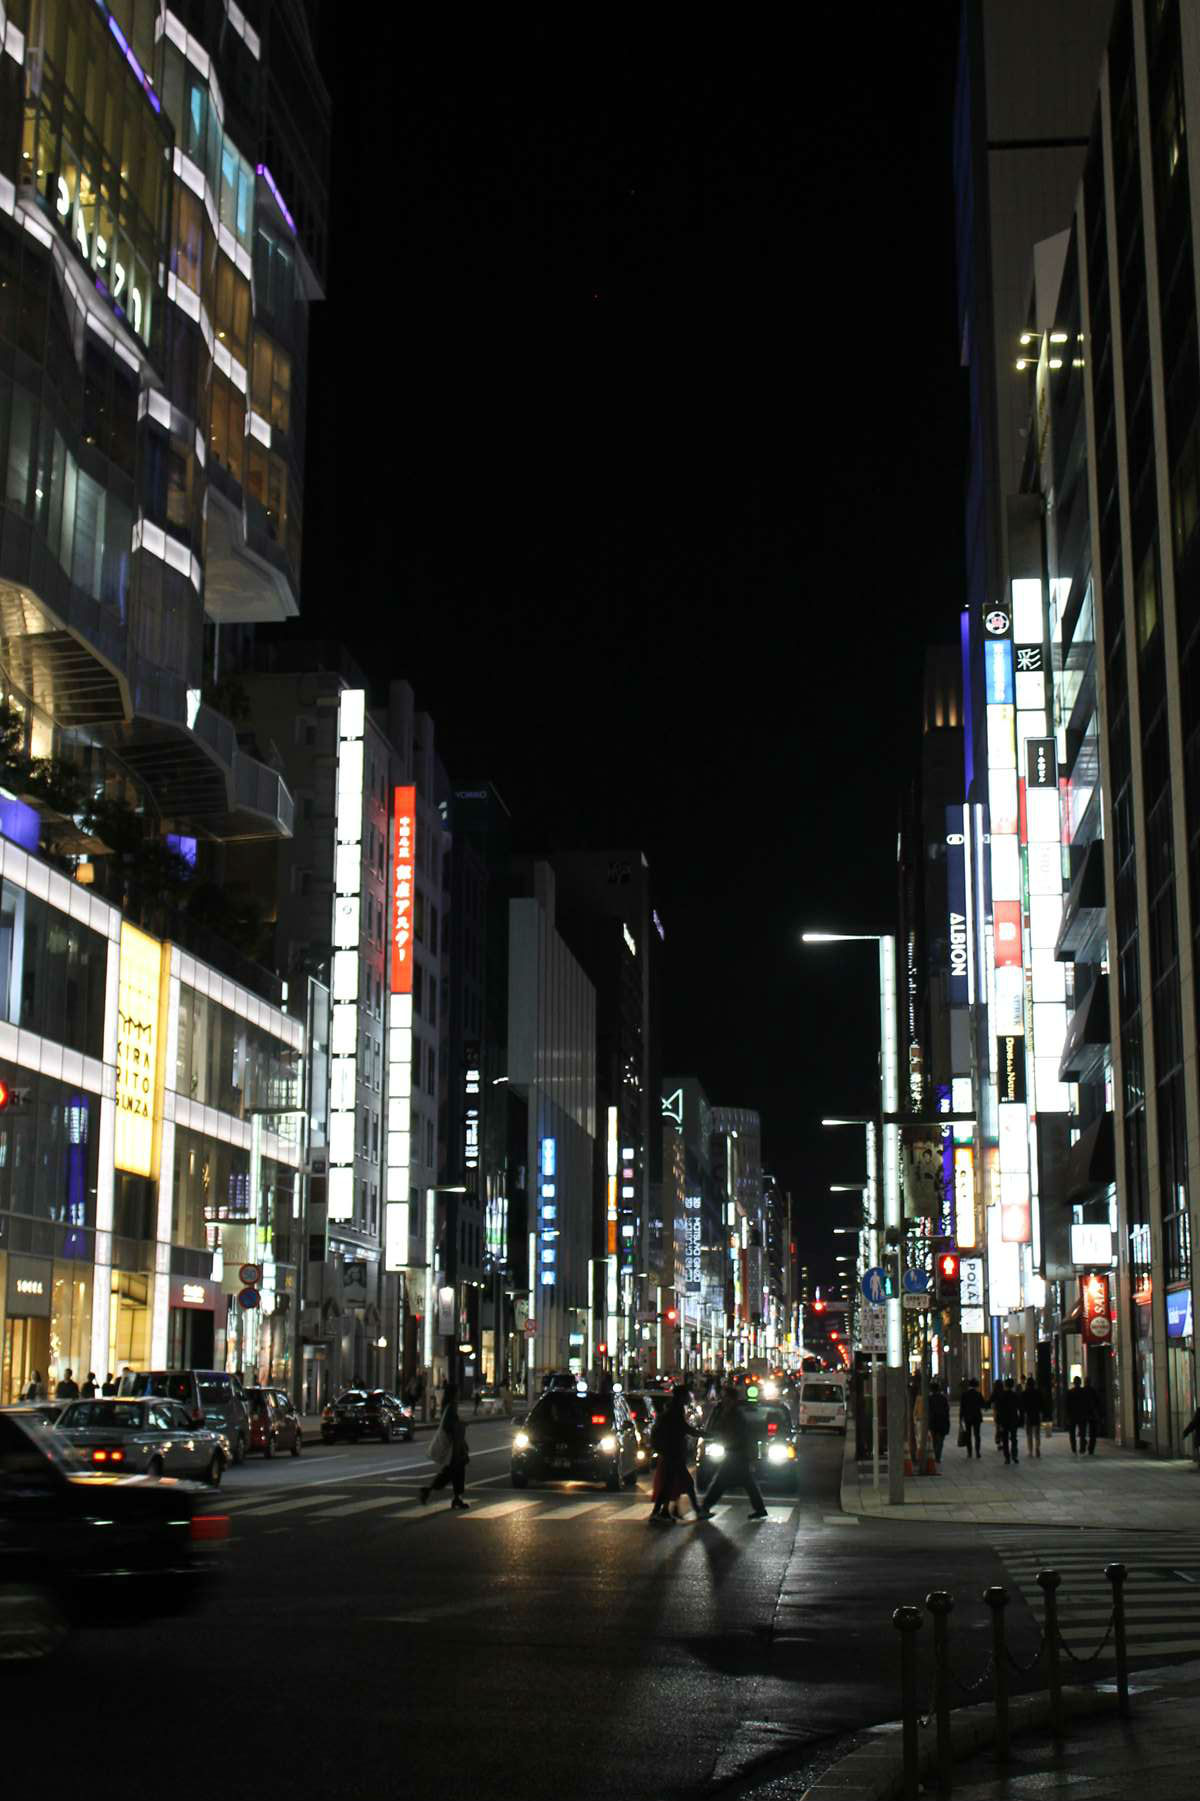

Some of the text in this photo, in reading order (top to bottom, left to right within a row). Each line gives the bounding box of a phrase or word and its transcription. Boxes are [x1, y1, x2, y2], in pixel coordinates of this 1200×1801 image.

[1016, 648, 1041, 670] 彩
[950, 912, 967, 977] ALBION
[117, 1041, 150, 1069] KIRA
[116, 1066, 150, 1094] RITO
[115, 1091, 148, 1118] GINZA
[967, 1263, 977, 1300] POLA
